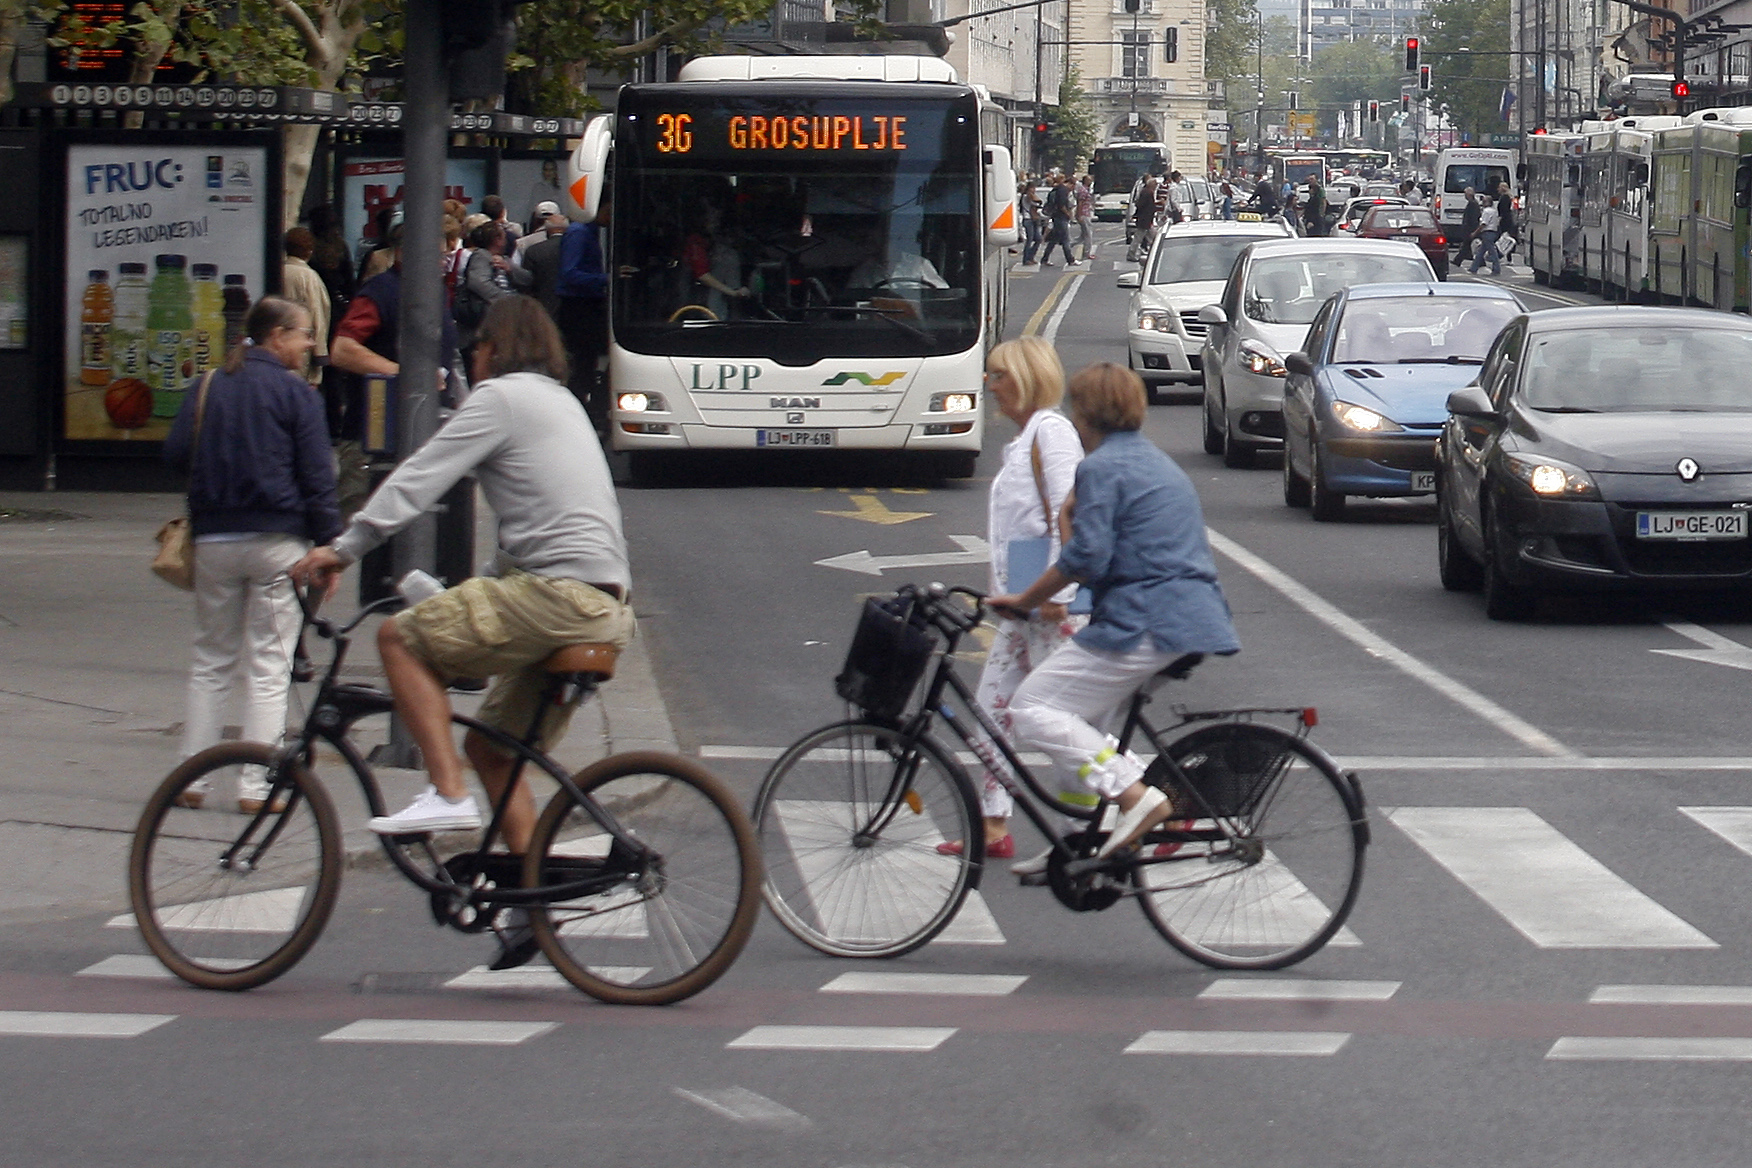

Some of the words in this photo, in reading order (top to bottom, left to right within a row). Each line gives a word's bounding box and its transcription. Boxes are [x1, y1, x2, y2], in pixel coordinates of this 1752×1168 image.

[656, 113, 694, 153] 3G
[728, 115, 908, 150] GROSUPLJE
[94, 216, 208, 248] LEGENDAREN!
[691, 363, 763, 391] LPP
[770, 397, 821, 409] MAN
[767, 432, 781, 445] LJ
[1418, 475, 1436, 488] KP
[1654, 517, 1674, 533] LJ
[1686, 516, 1741, 533] GE-021
